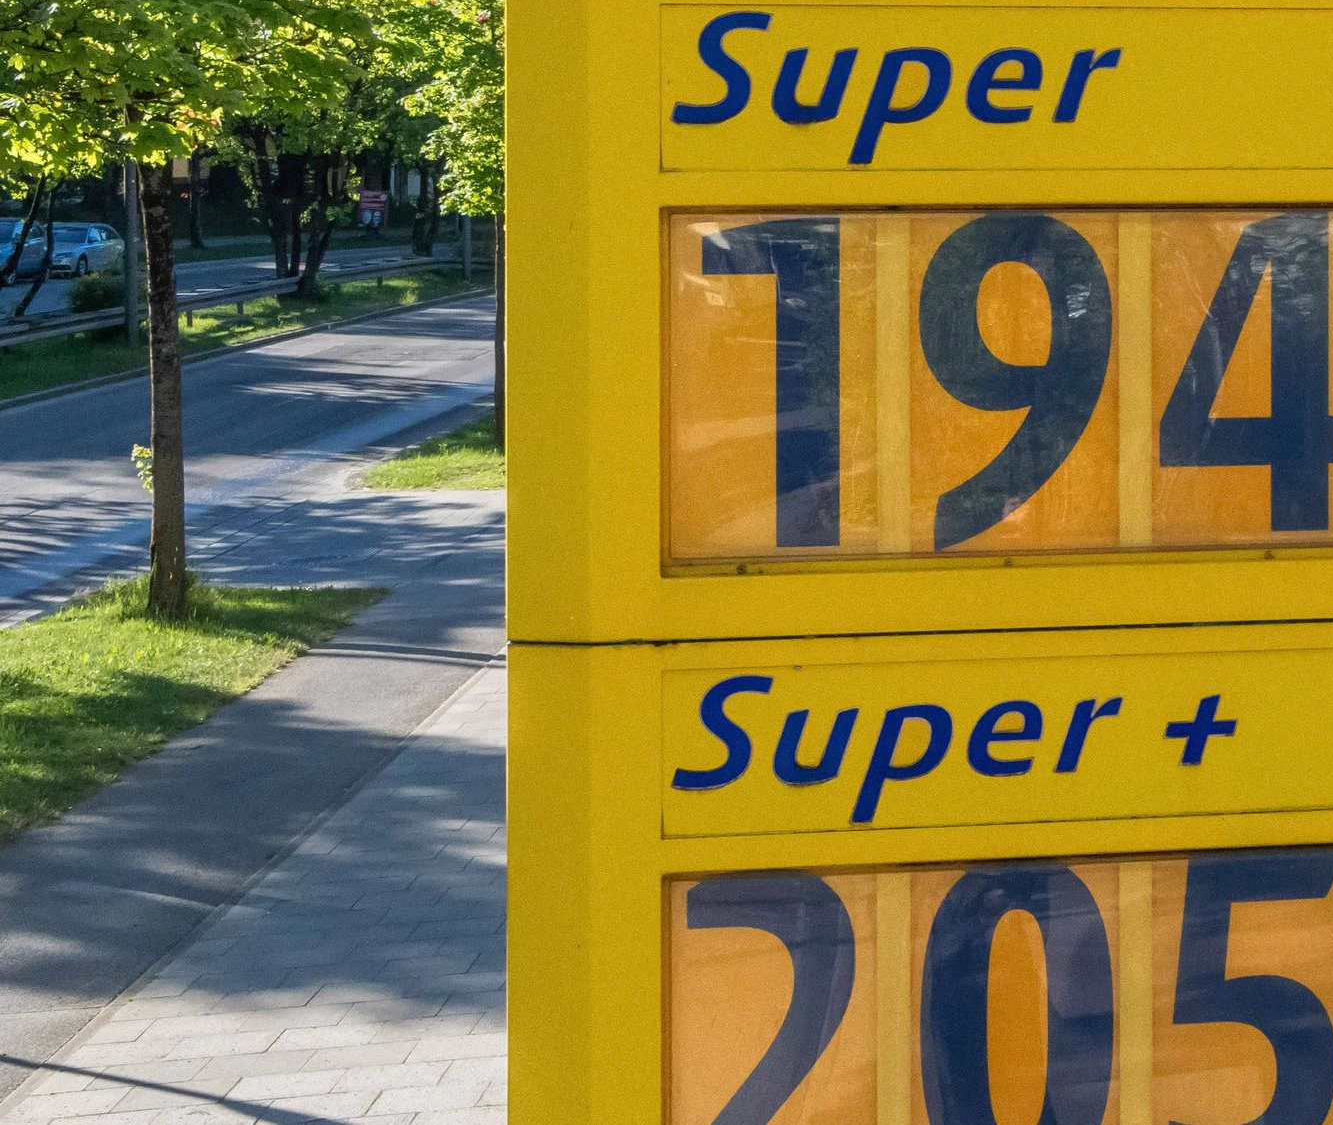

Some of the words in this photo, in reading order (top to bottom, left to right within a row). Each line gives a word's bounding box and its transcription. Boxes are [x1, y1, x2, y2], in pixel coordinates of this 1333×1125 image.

[670, 10, 1121, 164] Super
[670, 676, 1122, 824] Super
[1163, 695, 1239, 766] +
